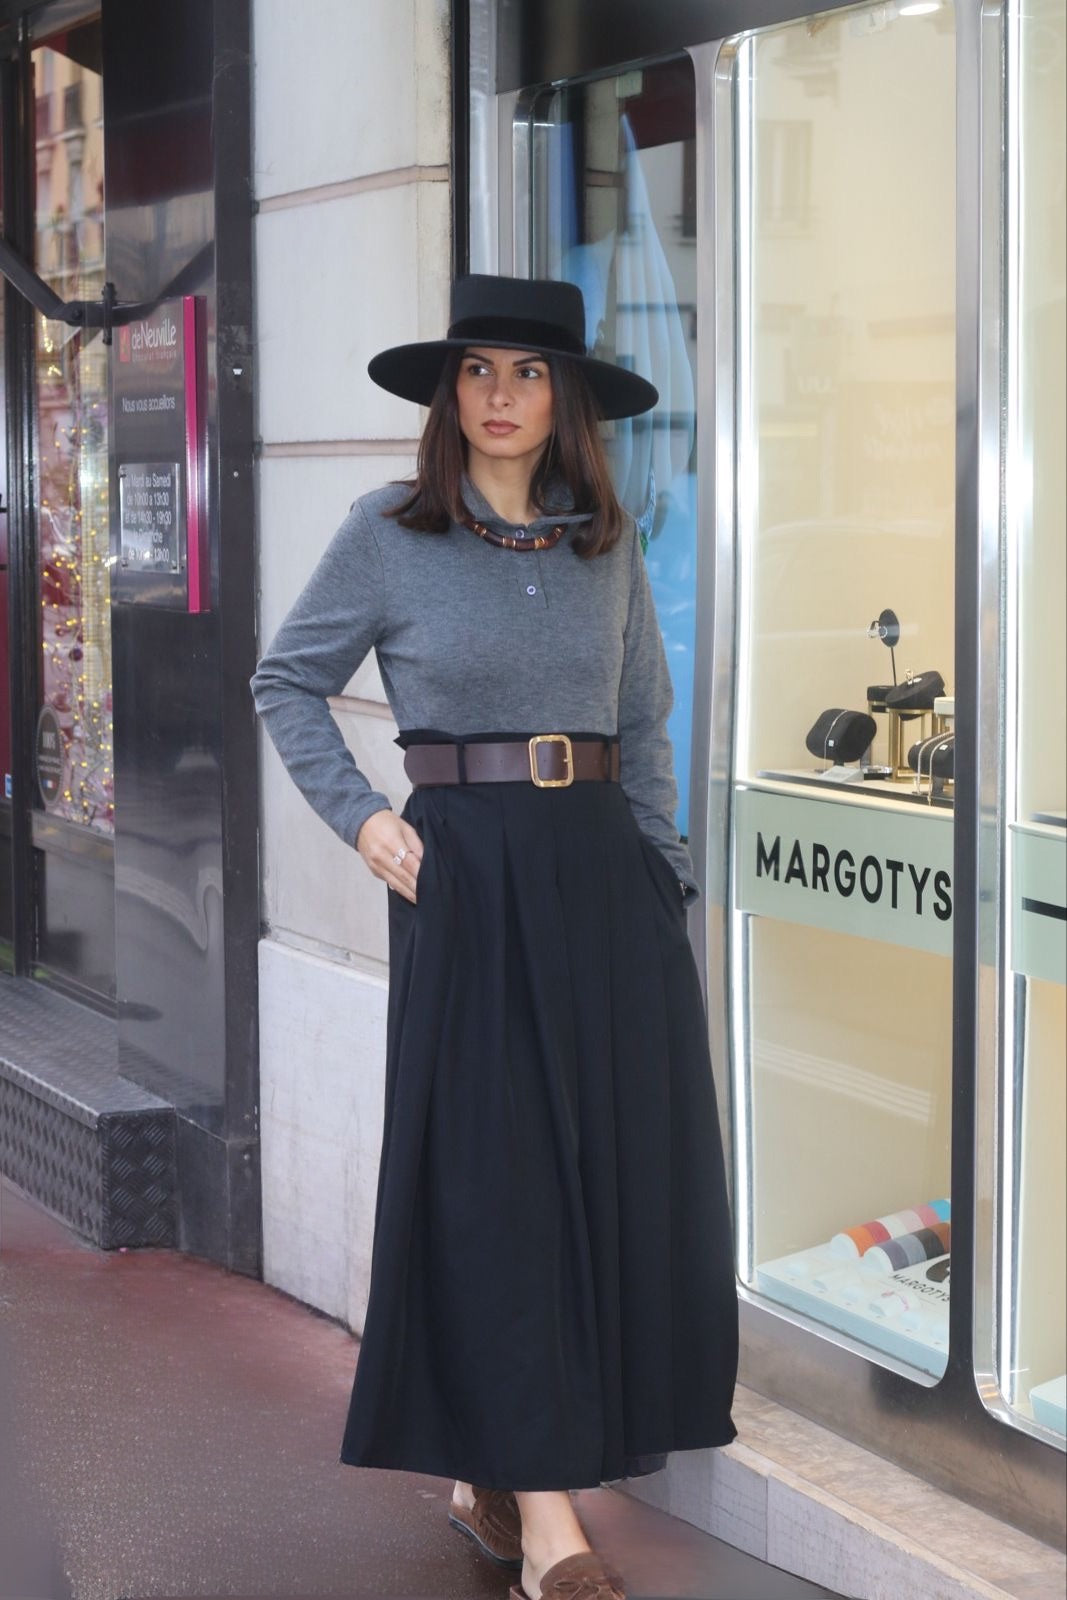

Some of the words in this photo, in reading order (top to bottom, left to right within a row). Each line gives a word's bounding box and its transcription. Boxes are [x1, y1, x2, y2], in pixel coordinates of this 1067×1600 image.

[131, 318, 177, 350] deNeuville
[122, 396, 135, 413] Nous
[136, 398, 148, 412] vous
[152, 472, 171, 488] Samedi
[138, 527, 163, 544] Dche
[756, 831, 953, 921] MARGOTYS
